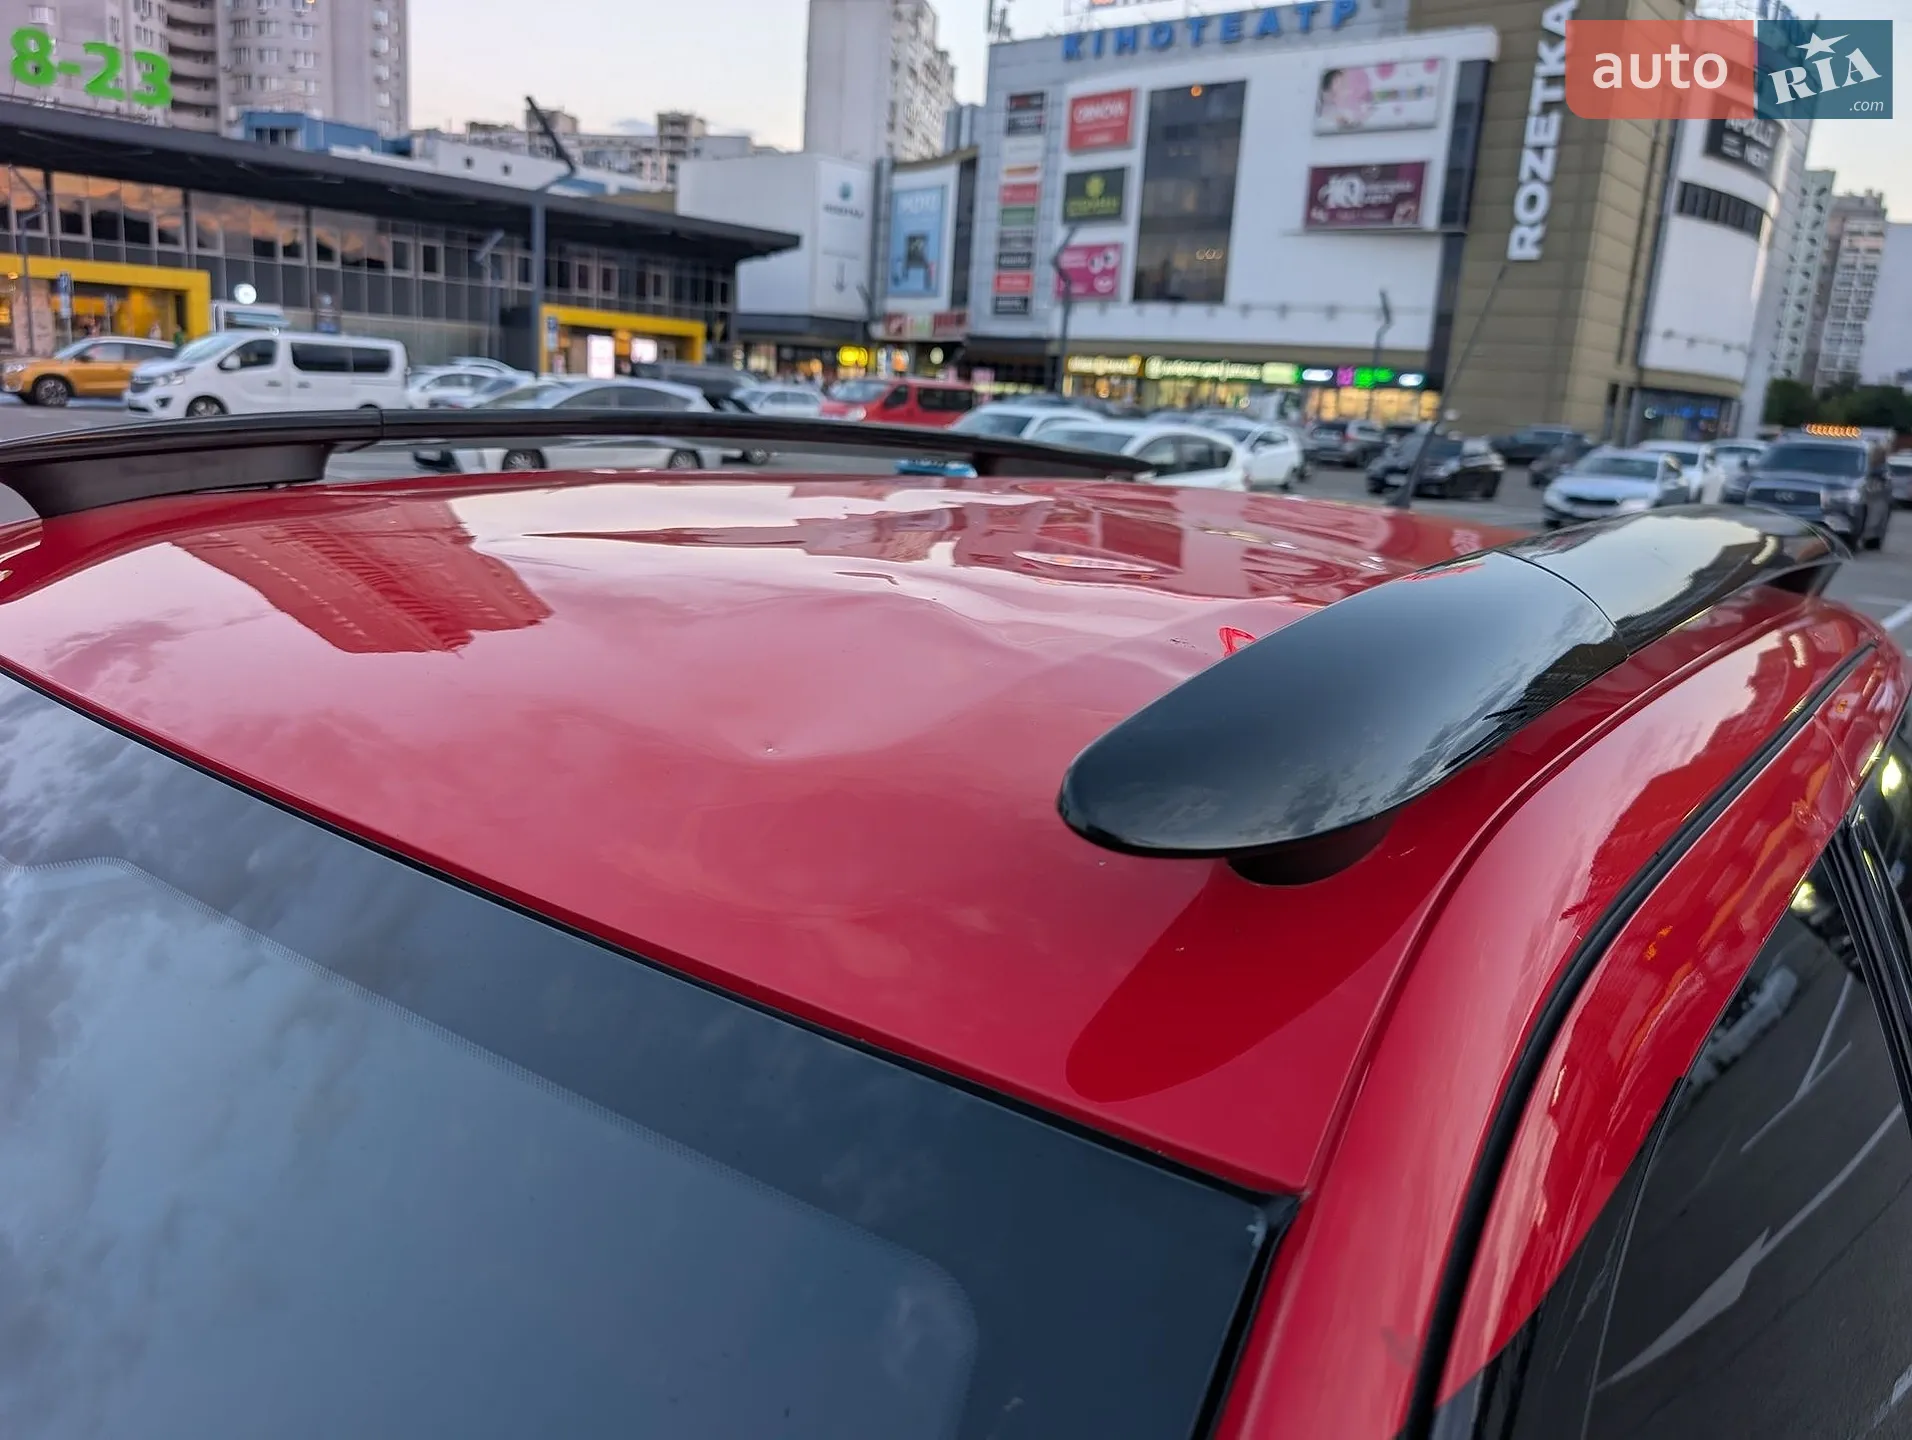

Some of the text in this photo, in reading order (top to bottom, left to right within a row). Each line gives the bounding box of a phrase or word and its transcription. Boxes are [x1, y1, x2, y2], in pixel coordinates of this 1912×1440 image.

[10, 27, 173, 106] 8-23
[1062, 0, 1358, 61] КІНОТЕАТР
[1507, 0, 1579, 261] ROZETKA
